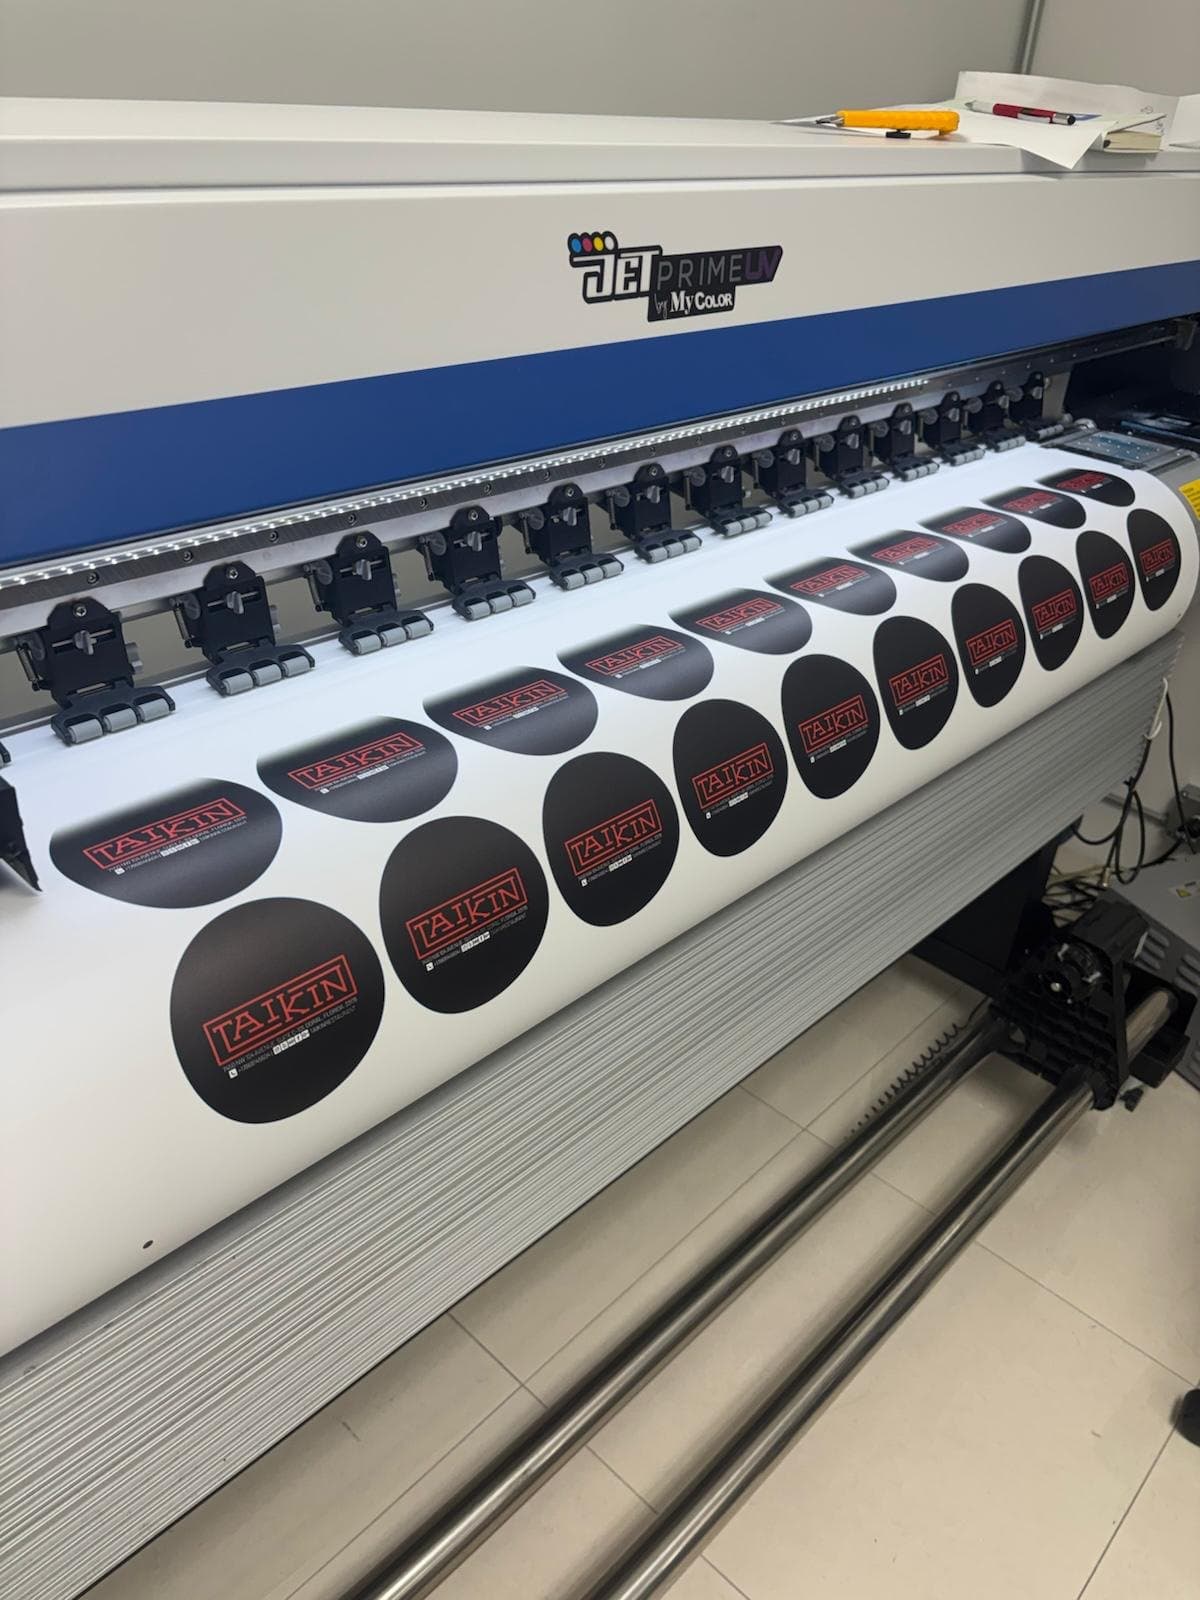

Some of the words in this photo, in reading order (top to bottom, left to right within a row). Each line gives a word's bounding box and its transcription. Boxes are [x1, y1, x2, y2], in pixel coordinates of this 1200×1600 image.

[572, 249, 660, 299] JET
[702, 601, 777, 629] TAIKIN
[591, 639, 678, 673] TAIKIN
[969, 623, 1014, 661] TAIKIN
[459, 683, 559, 723] TAIKIN
[893, 658, 944, 700] TAIKIN
[803, 700, 864, 747] TAIKIN
[296, 737, 416, 785] TAIKIN
[697, 749, 768, 804] TAIKIN
[93, 805, 237, 865] TAIKIN
[570, 807, 655, 870] TAIKIN
[411, 875, 521, 953] TAIKIN
[210, 963, 350, 1057] TAIKIN
